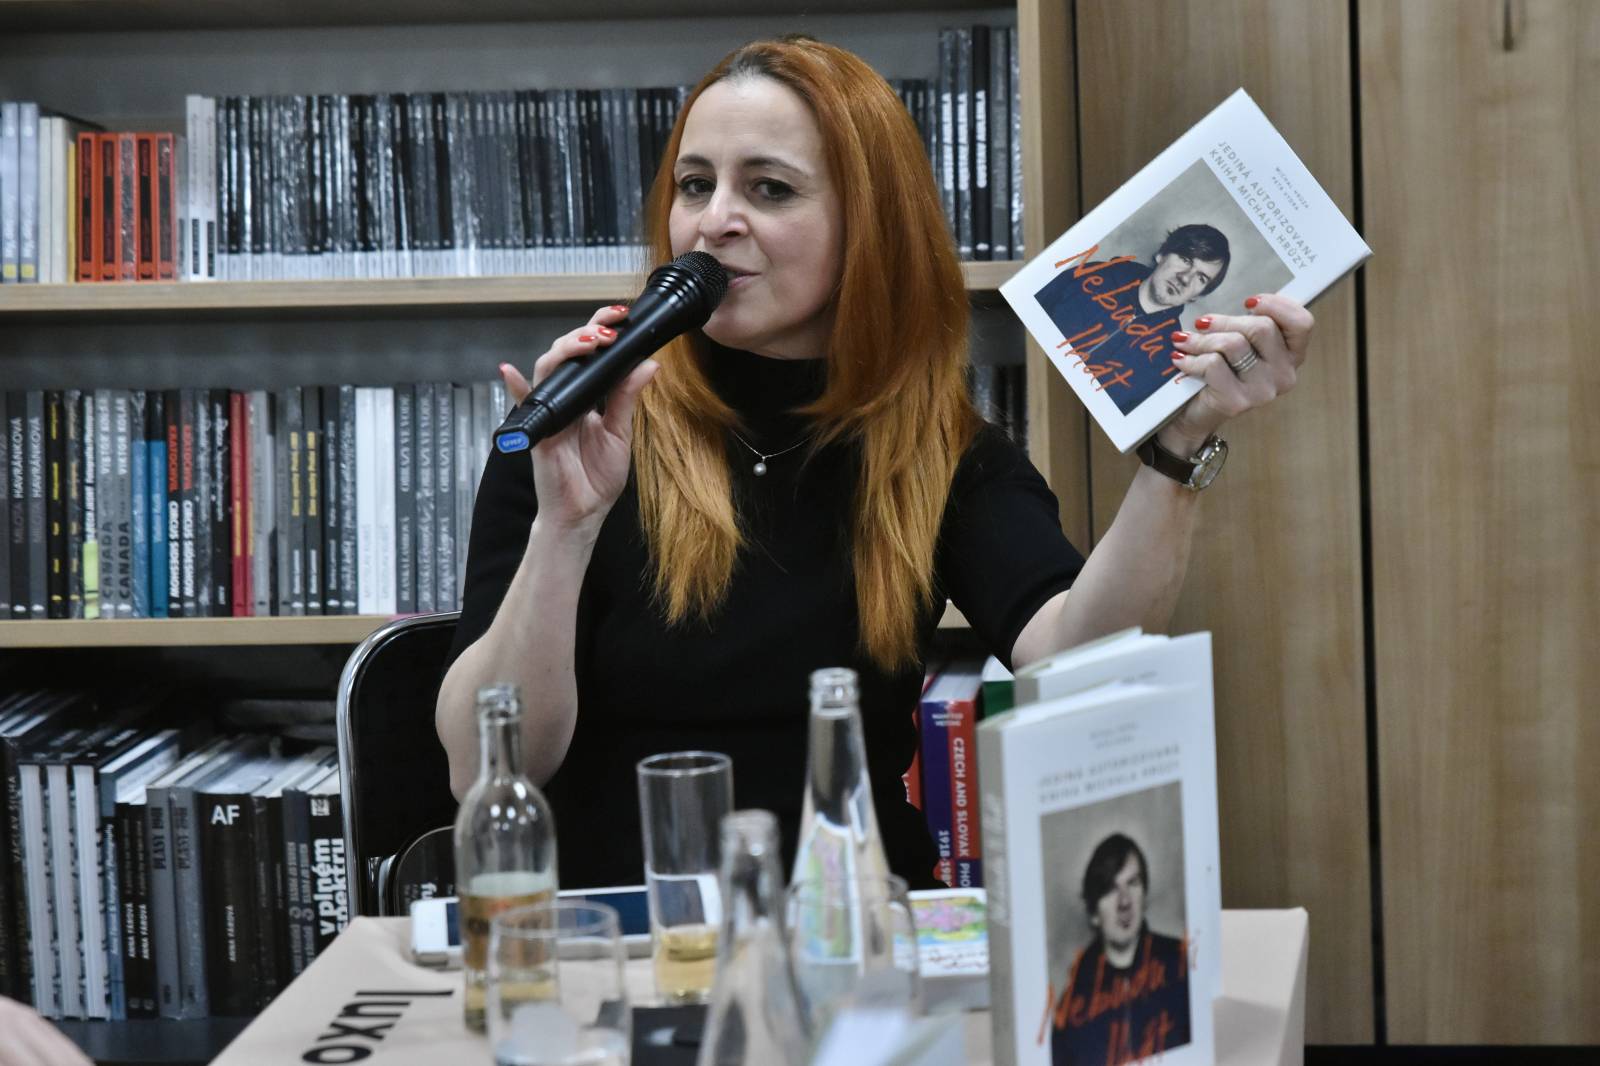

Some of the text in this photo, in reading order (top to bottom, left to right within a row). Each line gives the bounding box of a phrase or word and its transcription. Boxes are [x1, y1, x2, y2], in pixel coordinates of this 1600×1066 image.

[1209, 149, 1308, 269] KNIHA MICHALA HRŮZY
[1218, 141, 1318, 263] JEDINÁ AUTORIZOVANÁ
[1054, 244, 1176, 359] Nebudu
[1057, 323, 1132, 392] lhát
[12, 417, 23, 498] HAVRÁNKOVÁ
[30, 417, 42, 498] HAVRÁNKOVÁ
[117, 434, 127, 475] VIKTOR
[169, 500, 179, 540] CIRCUS
[183, 499, 194, 539] CIRCUS
[101, 521, 112, 599] CANADA
[118, 521, 130, 599] CANADA
[169, 541, 180, 598] SIDESHOW
[182, 541, 194, 598] SIDESHOW
[952, 737, 967, 778] CZECH
[211, 805, 240, 826] AF
[954, 781, 967, 806] AND
[956, 810, 970, 858] SLOVAK
[311, 839, 336, 917] plném
[320, 920, 335, 936] v
